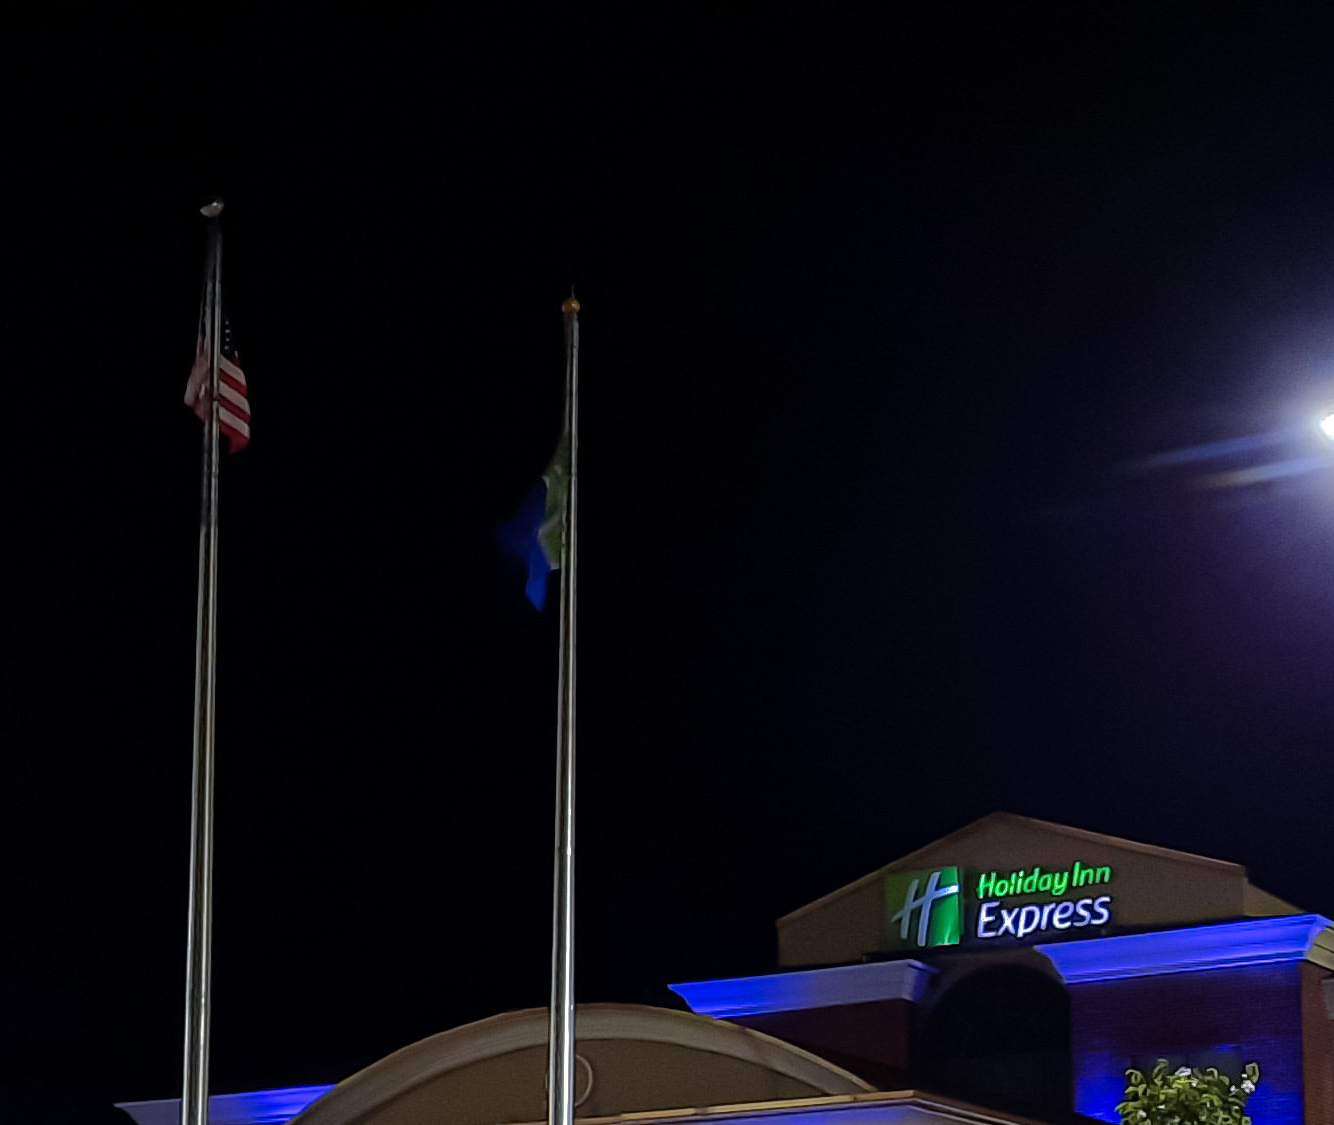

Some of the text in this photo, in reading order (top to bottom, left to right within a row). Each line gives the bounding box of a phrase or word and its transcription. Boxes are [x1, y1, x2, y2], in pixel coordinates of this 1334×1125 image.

[977, 861, 1111, 899] Holiday Inn
[977, 896, 1111, 938] Express
